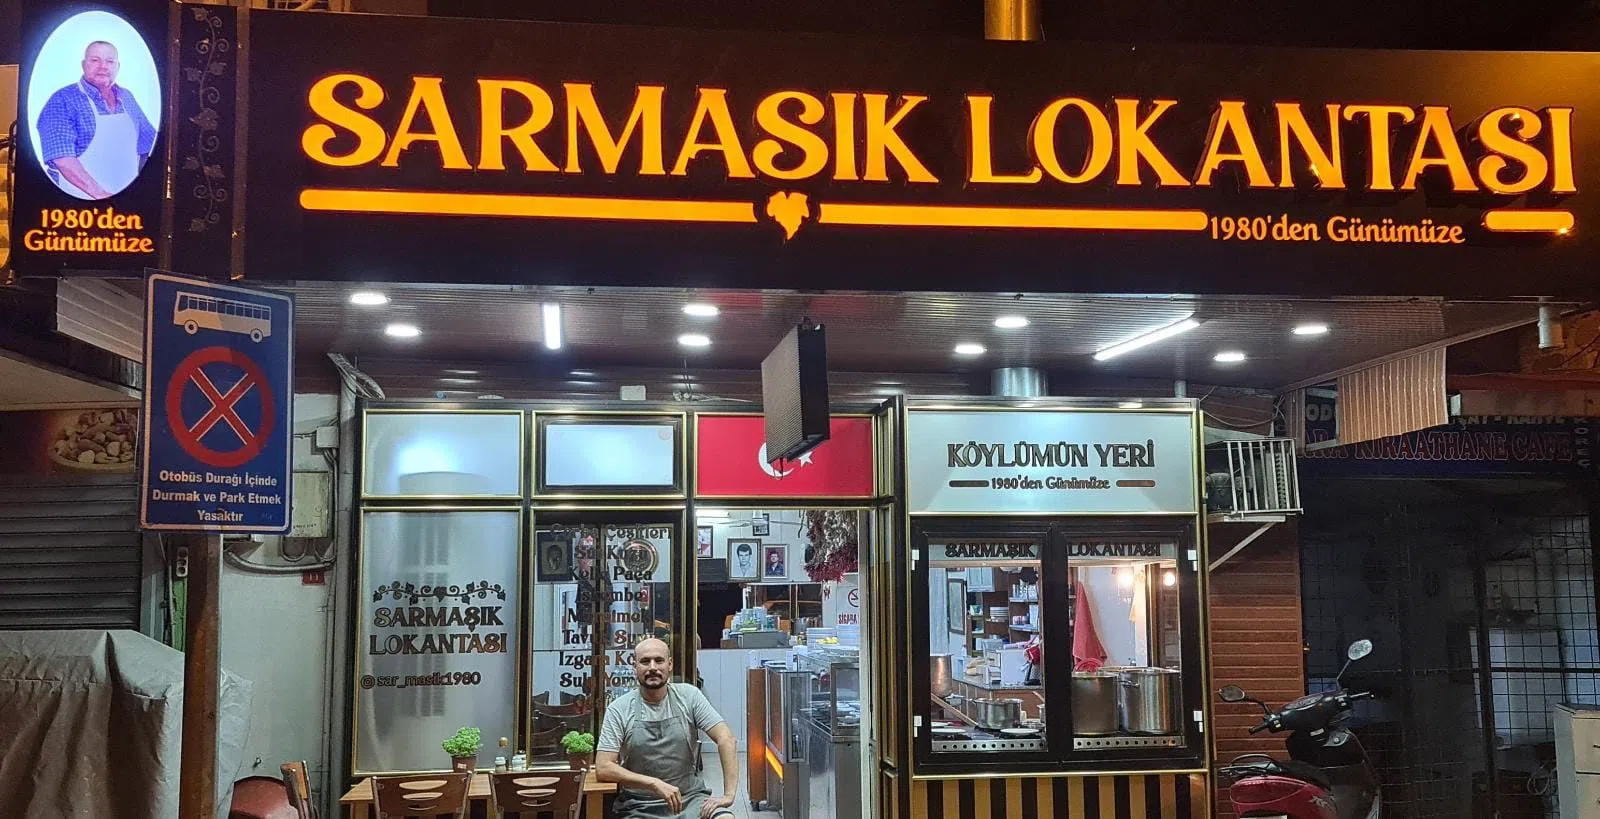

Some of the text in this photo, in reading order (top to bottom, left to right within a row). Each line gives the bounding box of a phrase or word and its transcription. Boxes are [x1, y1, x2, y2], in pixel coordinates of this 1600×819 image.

[965, 95, 1577, 195] LOKANTASI
[41, 206, 144, 230] 1980'den
[1210, 214, 1466, 244] 1980'den Günümüze
[24, 229, 155, 253] Günümüze
[947, 438, 1156, 468] KÖYLÜMÜN YERİ
[159, 470, 278, 488] Otobüs Durağı İçinde
[991, 475, 1111, 490] 1980'den Günümüze
[152, 489, 282, 506] Durmak ve Park Etmek
[197, 509, 244, 522] Yasaktır
[1067, 543, 1161, 557] LOKANTASI
[369, 632, 508, 655] LOKANTASI
